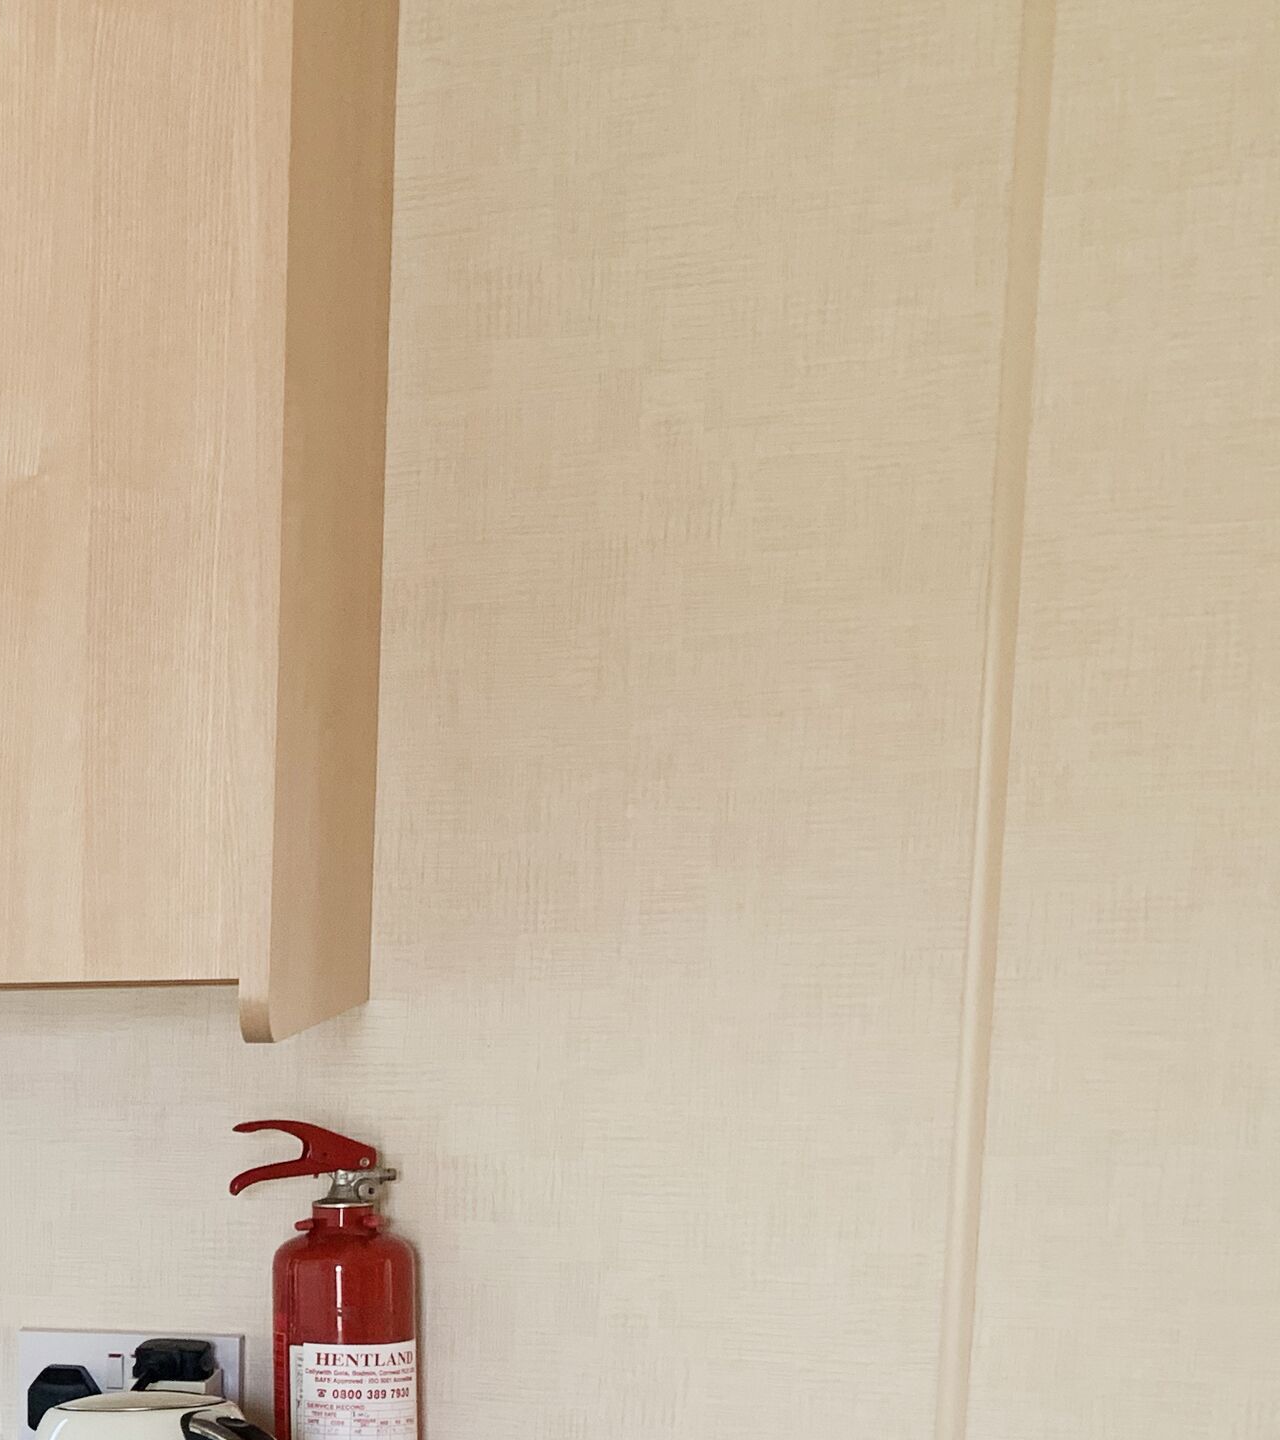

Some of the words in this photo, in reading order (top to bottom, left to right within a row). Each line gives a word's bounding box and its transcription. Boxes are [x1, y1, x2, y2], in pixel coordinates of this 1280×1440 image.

[316, 1351, 414, 1367] HENTLAND
[332, 1389, 362, 1400] 0800
[366, 1389, 387, 1399] 389
[306, 1402, 334, 1410] SERVICE
